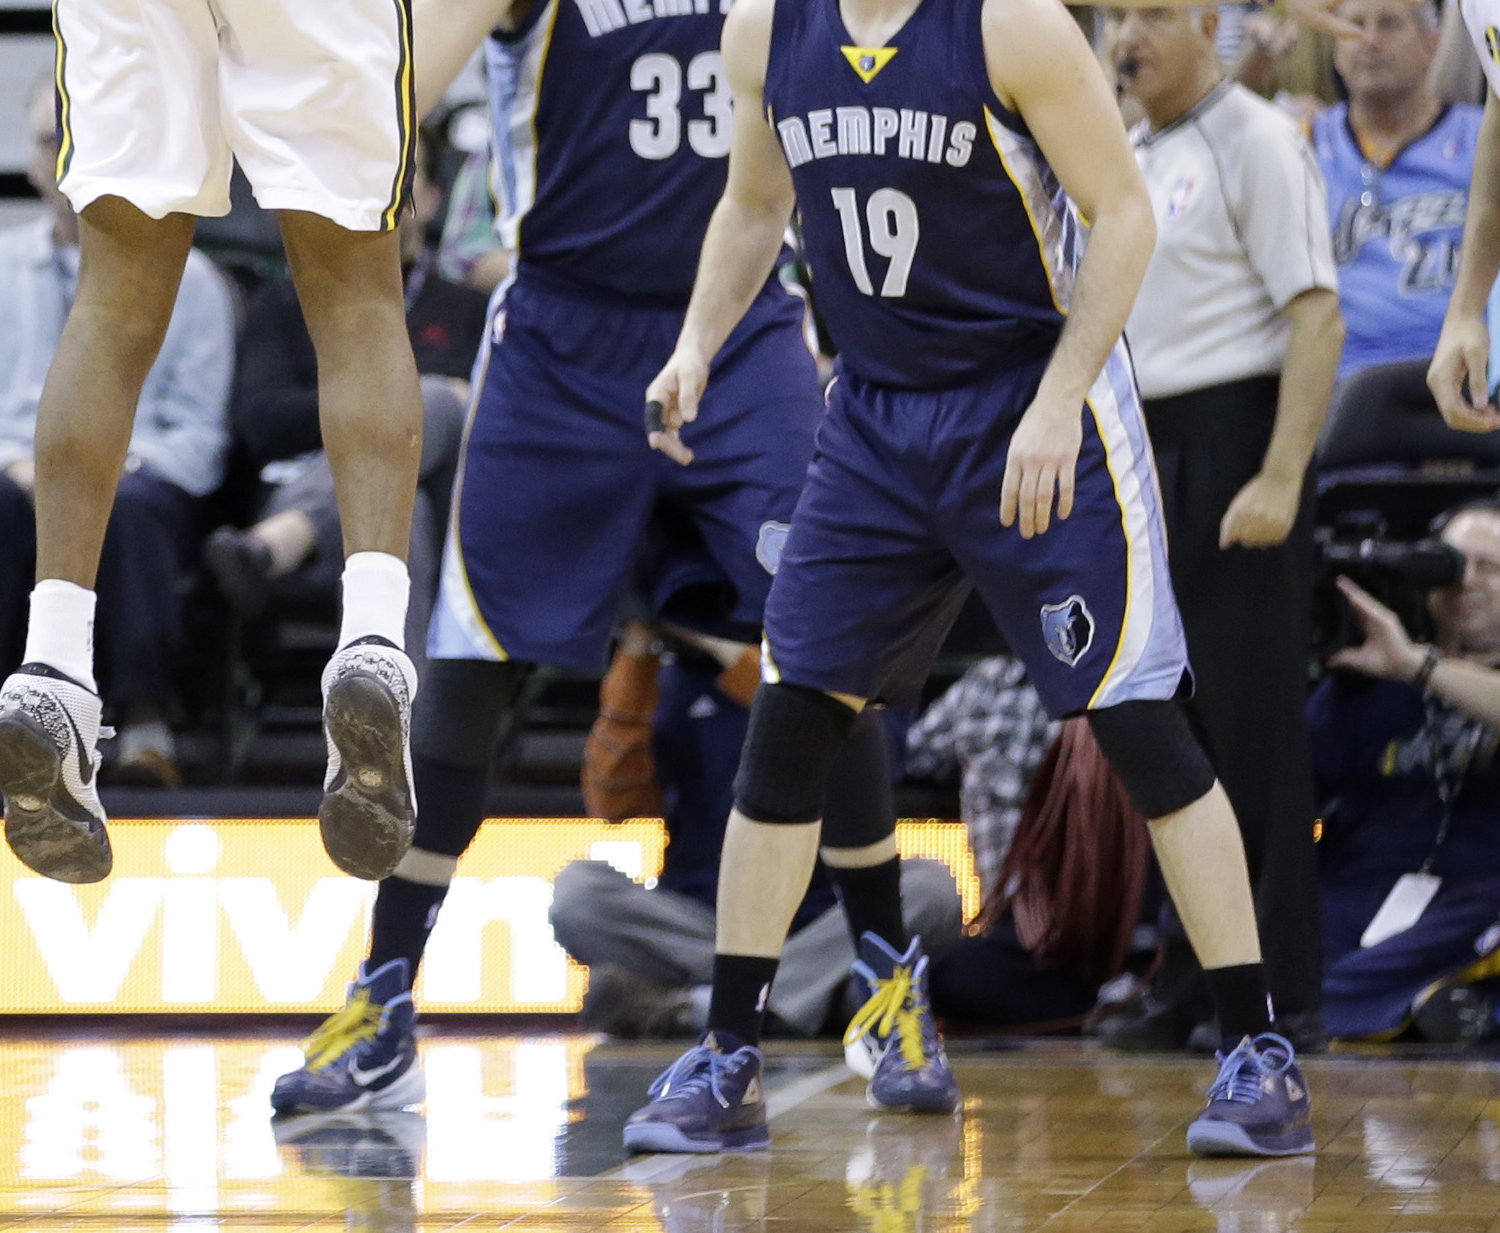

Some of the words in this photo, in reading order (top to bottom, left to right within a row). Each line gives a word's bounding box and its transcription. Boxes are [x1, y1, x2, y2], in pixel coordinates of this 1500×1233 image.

[629, 50, 736, 160] 33
[777, 106, 977, 168] MEMPHIS
[830, 187, 919, 297] 19
